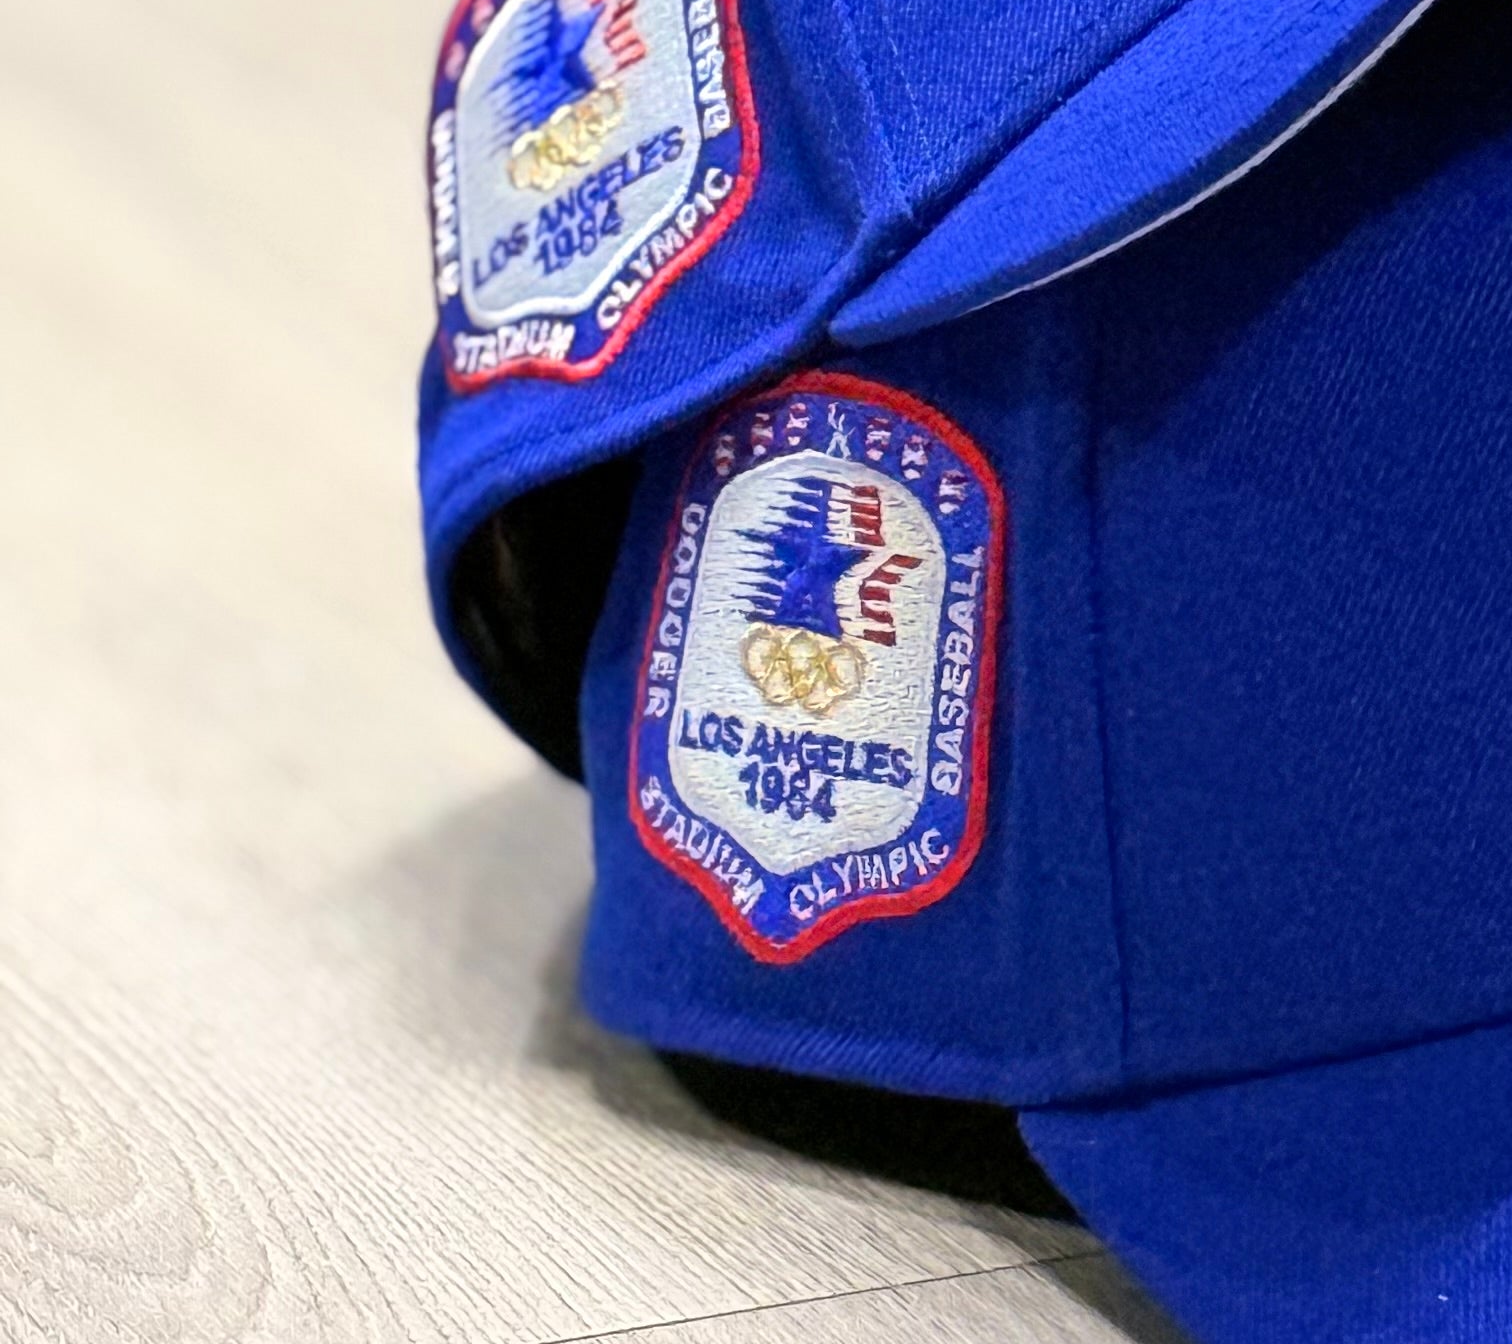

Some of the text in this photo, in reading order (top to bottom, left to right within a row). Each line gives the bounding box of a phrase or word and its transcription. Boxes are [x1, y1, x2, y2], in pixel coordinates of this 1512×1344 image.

[473, 222, 529, 291] LOS
[534, 126, 685, 238] ANGELES
[536, 200, 622, 277] 1984
[597, 166, 733, 331] OLYMPIC
[453, 319, 576, 374] STADIUM
[932, 545, 985, 796] BASEBALL
[679, 708, 914, 788] LOS ANGELES
[738, 761, 837, 824] 1984
[640, 775, 766, 915] STADIUM
[788, 829, 950, 920] OLYMPIC
